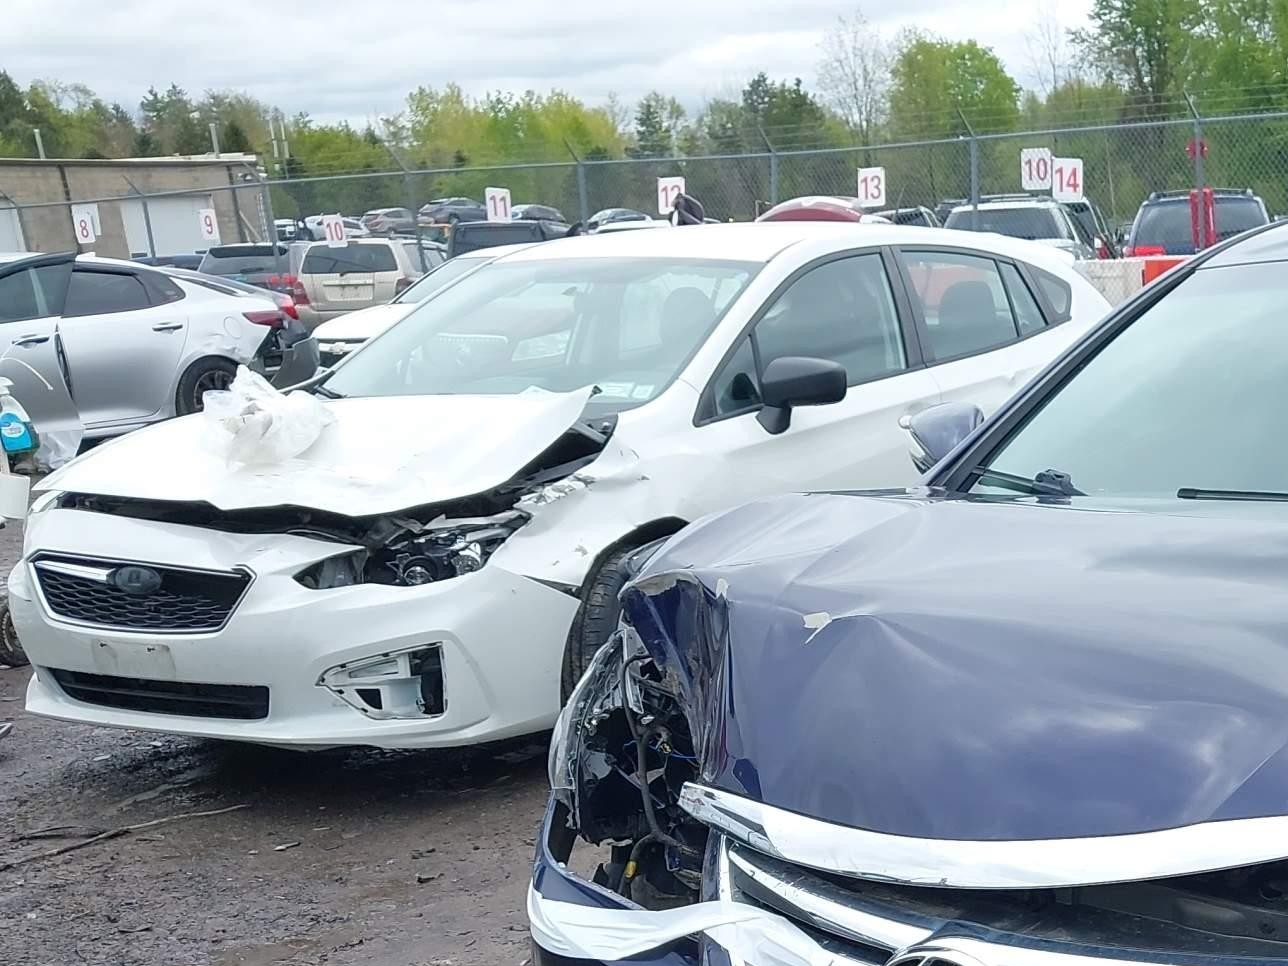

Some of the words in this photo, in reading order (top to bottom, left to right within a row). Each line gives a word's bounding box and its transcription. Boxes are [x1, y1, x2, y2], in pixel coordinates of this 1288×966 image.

[1024, 158, 1048, 182] 10
[1055, 167, 1080, 193] 14
[860, 175, 881, 200] 13
[489, 195, 508, 218] 11
[80, 219, 89, 239] 8
[204, 215, 213, 235] 9
[326, 222, 343, 241] 10
